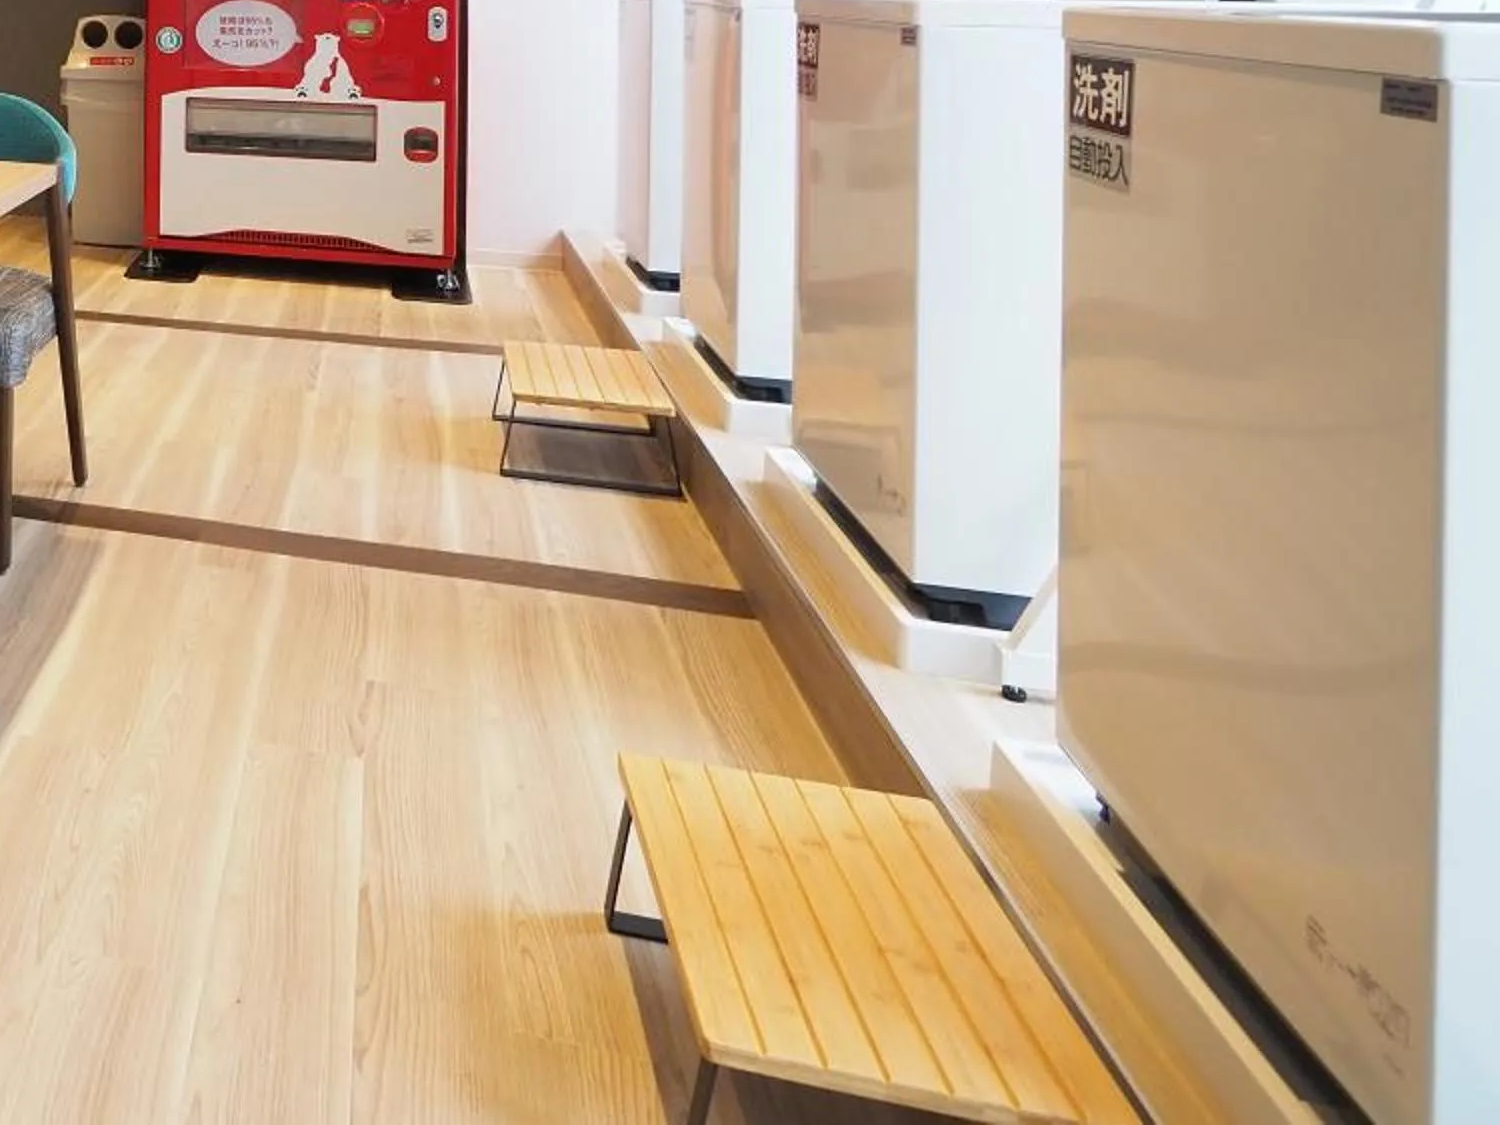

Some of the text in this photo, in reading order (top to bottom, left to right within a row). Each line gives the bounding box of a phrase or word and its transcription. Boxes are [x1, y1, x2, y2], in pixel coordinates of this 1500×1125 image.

[1073, 62, 1129, 128] 洗剤
[1069, 134, 1129, 187] 自動投入
